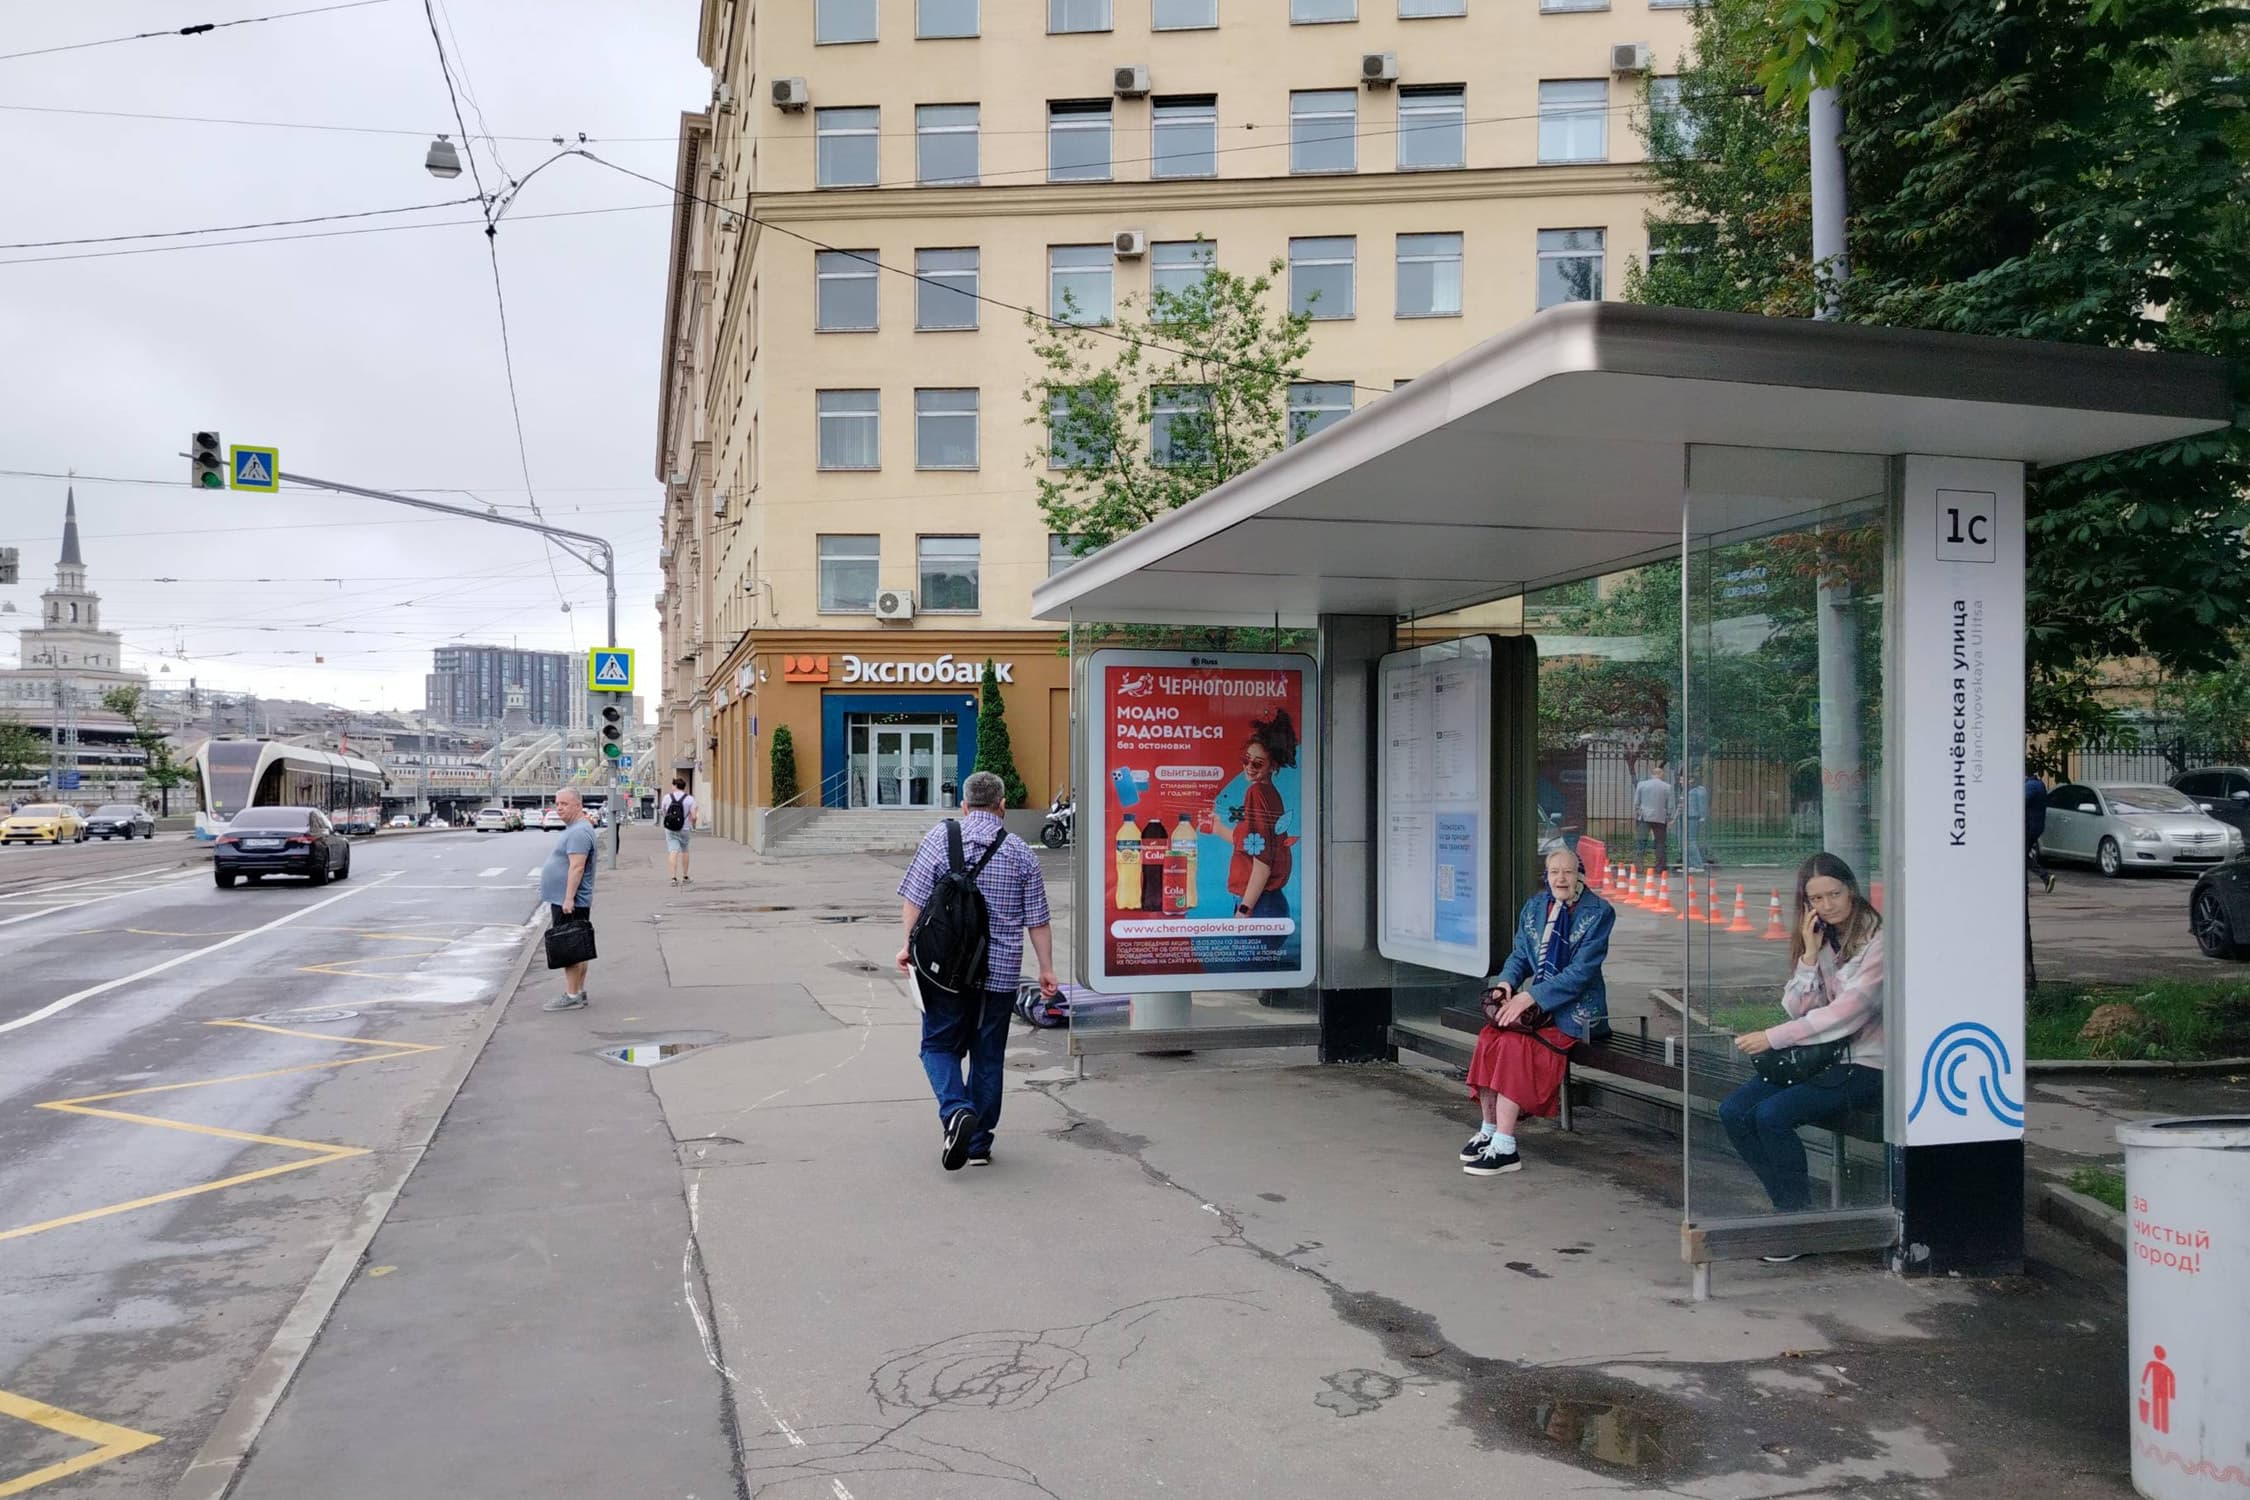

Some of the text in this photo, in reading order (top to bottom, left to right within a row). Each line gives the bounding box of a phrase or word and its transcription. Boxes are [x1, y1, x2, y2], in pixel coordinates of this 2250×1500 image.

[1159, 676, 1287, 697] ЧЕРНОГОЛОВКА
[1971, 600, 1984, 783] Kalanchyovskaya Ulitsa
[1117, 706, 1180, 721] МОДНО
[1950, 600, 1969, 846] Каланчёвская улица
[1117, 724, 1224, 739] РАДОВАТЬСЯ
[1117, 741, 1135, 750] без
[1160, 767, 1220, 777] ВЫИГРЫВАЙ
[1144, 851, 1165, 860] Cola
[1164, 886, 1185, 894] Cola
[1123, 924, 1286, 934] www.chernogolovka-promo.ru
[2133, 1194, 2148, 1213] за
[2134, 1219, 2209, 1249] чистый
[2133, 1241, 2200, 1275] город!
